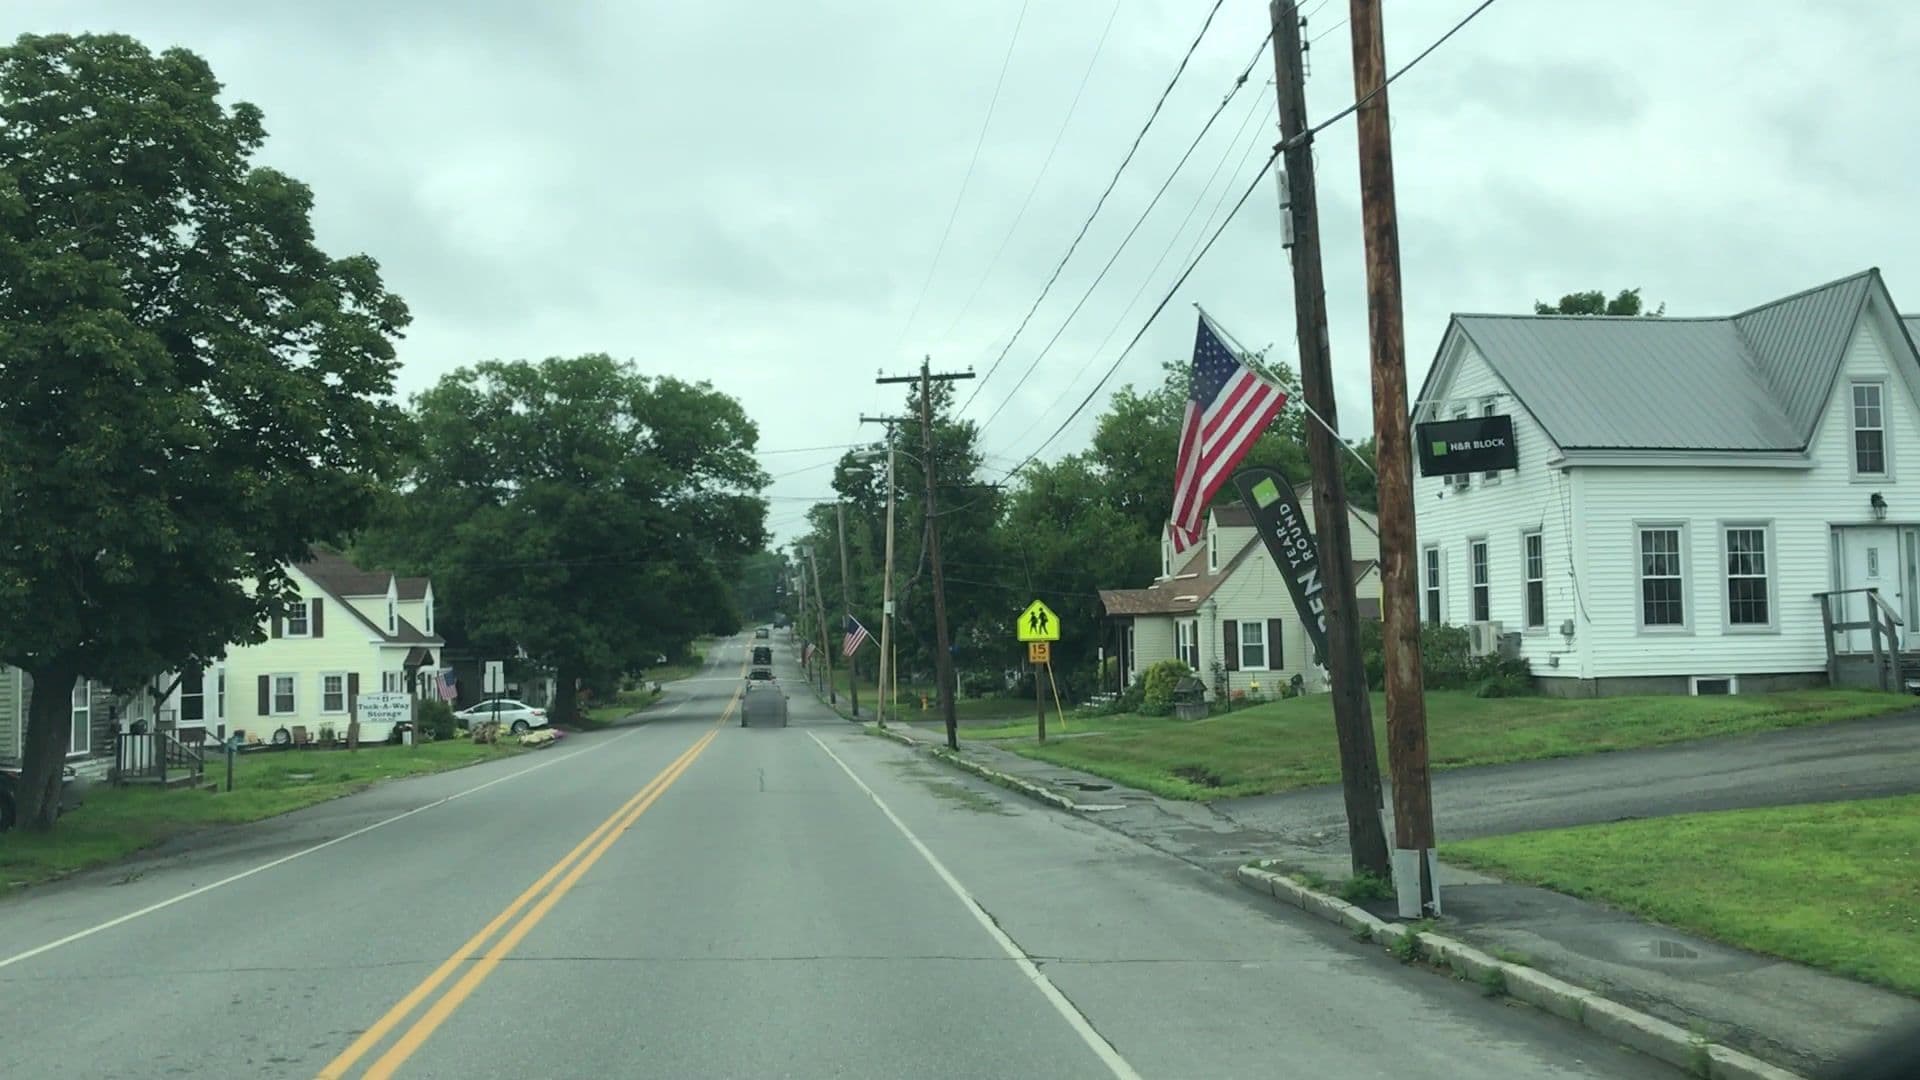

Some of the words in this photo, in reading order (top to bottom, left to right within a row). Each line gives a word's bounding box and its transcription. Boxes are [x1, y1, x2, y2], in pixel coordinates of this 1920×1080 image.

[1450, 441, 1472, 452] H&R
[1473, 438, 1505, 449] BLOCK
[1279, 503, 1314, 561] ROUND
[1032, 644, 1046, 655] 15
